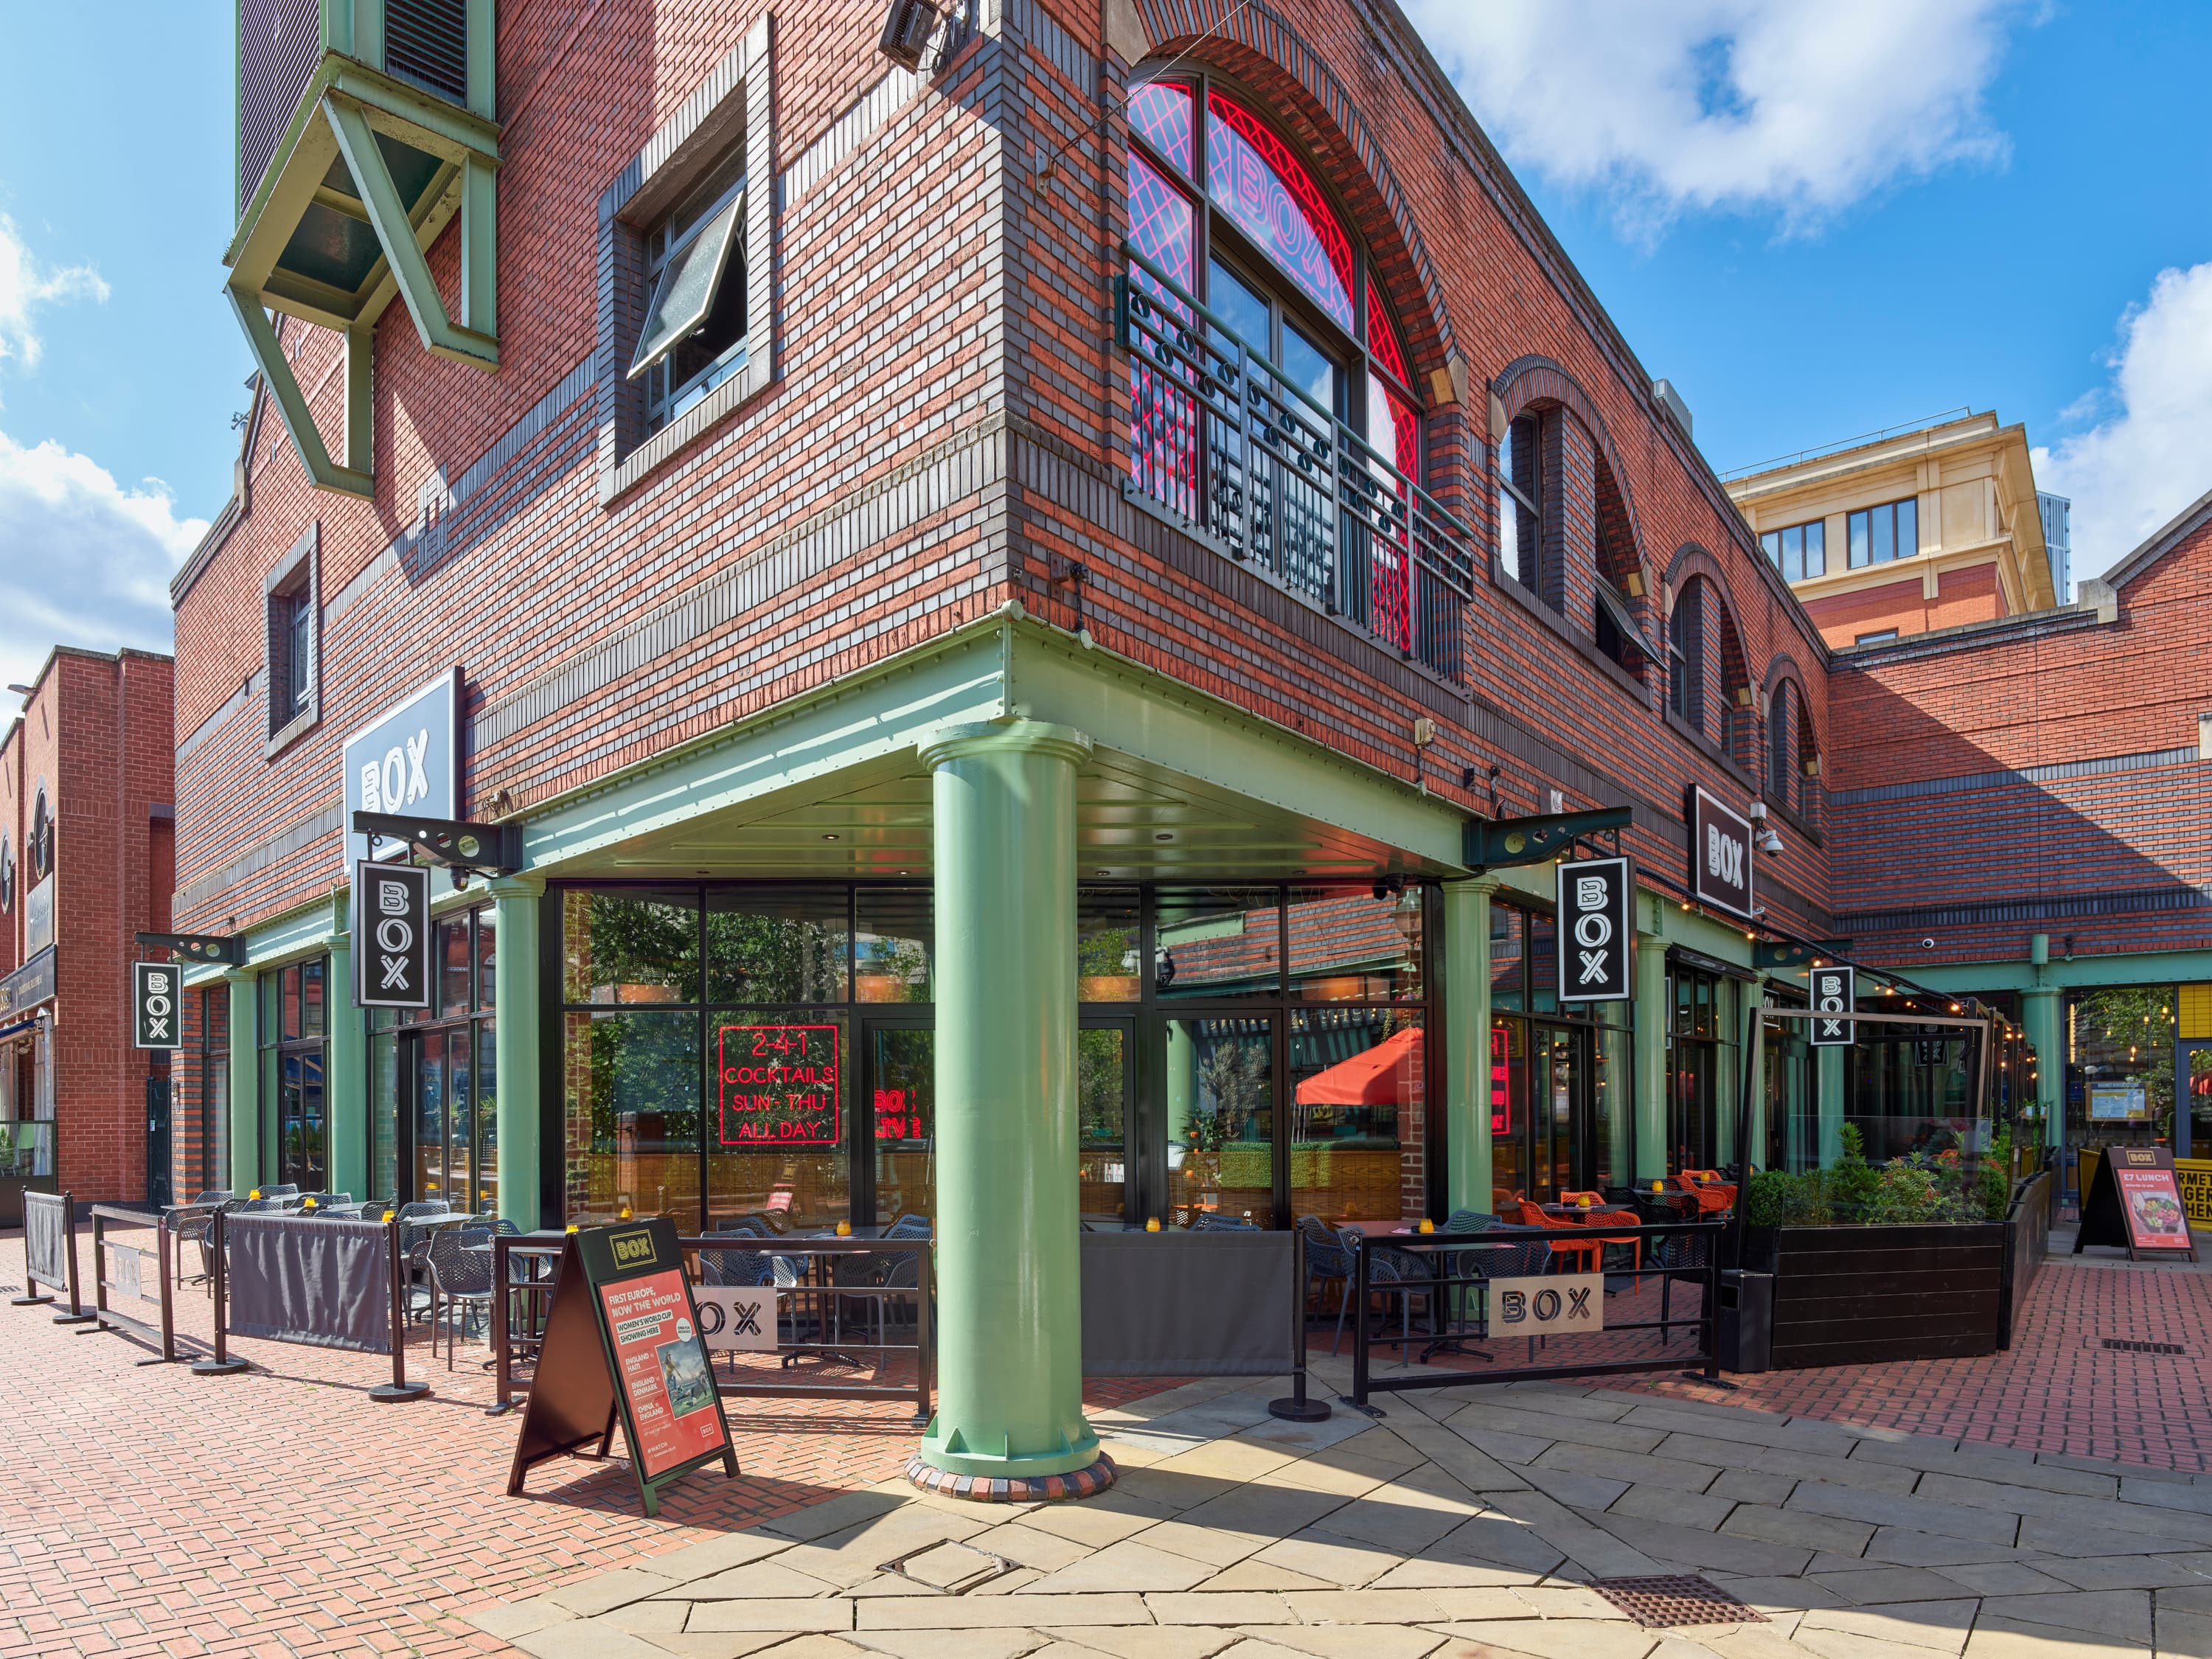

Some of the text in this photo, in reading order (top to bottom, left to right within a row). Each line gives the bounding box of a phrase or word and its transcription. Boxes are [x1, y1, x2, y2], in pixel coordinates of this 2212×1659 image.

[1237, 139, 1327, 288] BOX
[361, 728, 429, 814] BOX
[1708, 824, 1743, 890] BOX
[376, 880, 414, 990] BOX
[1574, 876, 1613, 985] BOX
[146, 972, 171, 1039] BOX
[1820, 975, 1844, 1037] BOX
[752, 1032, 807, 1056] 2-4-1
[724, 1066, 835, 1085] COCKTAILS
[732, 1093, 771, 1111] SUN
[785, 1093, 827, 1111] THU
[738, 1121, 821, 1138] ALL DAY
[2129, 1153, 2152, 1162] BOX
[2135, 1173, 2169, 1181] LUNCH
[616, 1237, 650, 1260] BOX
[608, 1286, 656, 1306] FIRST EUROPE,
[611, 1292, 681, 1318] NOW THE WORLD
[1502, 1287, 1591, 1324] BOX
[617, 1311, 672, 1332] WOMEN'S WORLD CUP
[696, 1301, 762, 1336] OX
[620, 1326, 660, 1343] SHOWING HERE
[625, 1352, 650, 1366] ENGLAND
[627, 1363, 641, 1373] HAITI
[631, 1376, 655, 1390] ENGLAND
[633, 1382, 658, 1397] DENMARK
[638, 1402, 655, 1413] CHINA
[639, 1407, 664, 1421] ENGLAND
